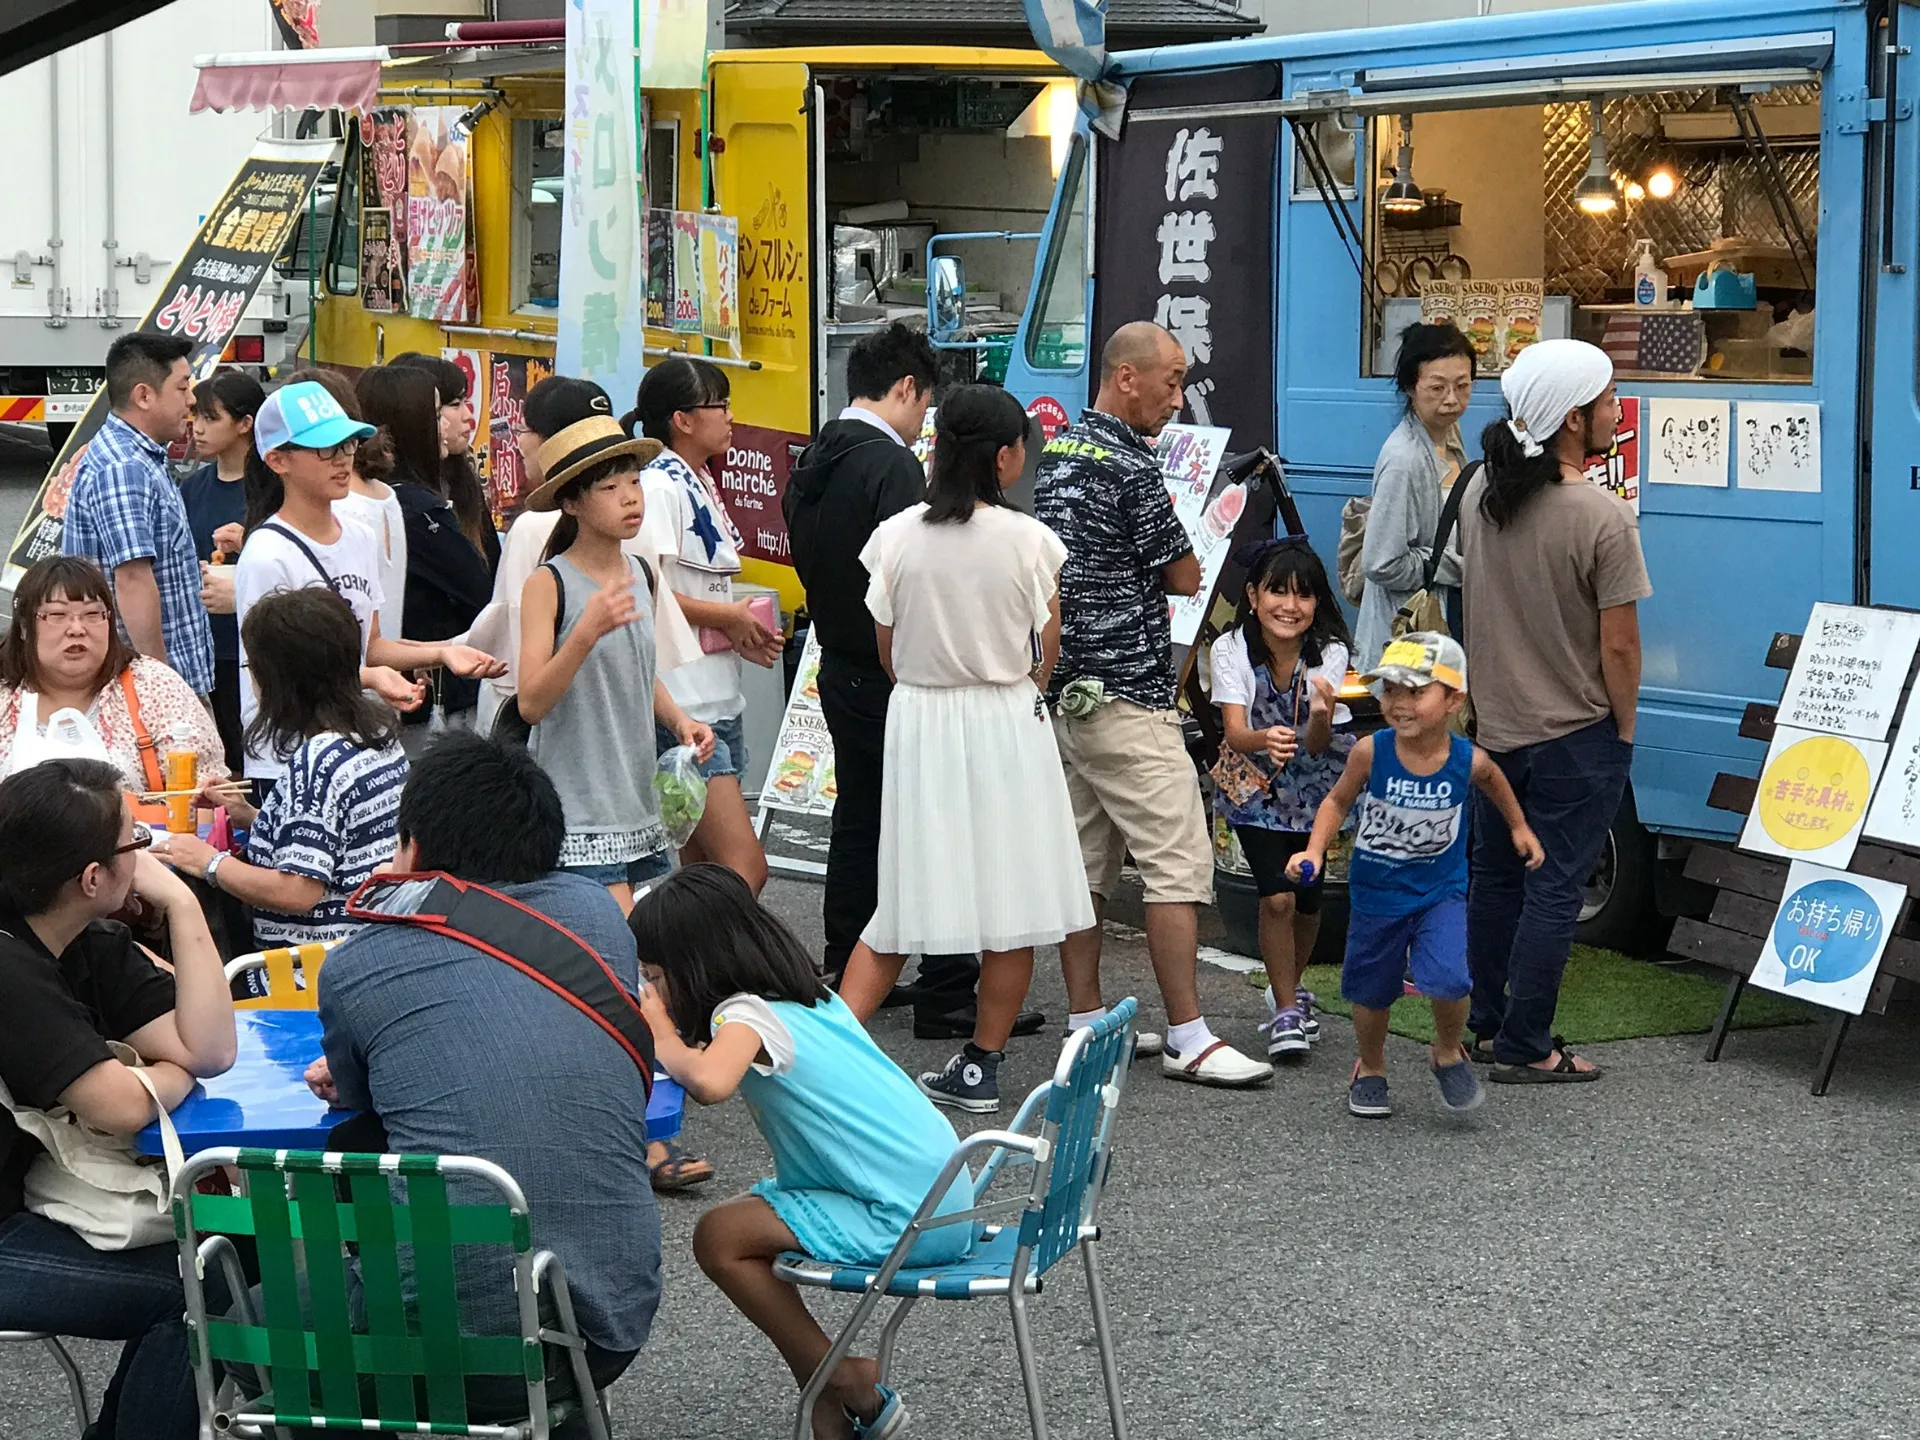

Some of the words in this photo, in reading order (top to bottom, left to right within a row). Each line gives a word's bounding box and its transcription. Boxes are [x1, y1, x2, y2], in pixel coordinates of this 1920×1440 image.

[211, 206, 288, 253] 金賞受賞
[1424, 281, 1456, 296] SASEBO
[1462, 281, 1497, 296] SASEBO
[1503, 280, 1540, 296] SASEBO
[676, 301, 698, 320] 200円
[760, 287, 792, 318] ファーム
[727, 447, 772, 471] Donne
[722, 470, 777, 496] marché
[757, 528, 791, 556] http://
[1386, 776, 1452, 799] HELLO
[1773, 777, 1854, 813] 苦手な具材は
[1404, 797, 1439, 809] NAME
[1787, 895, 1880, 941] お持ち帰り
[1789, 944, 1822, 974] OK
